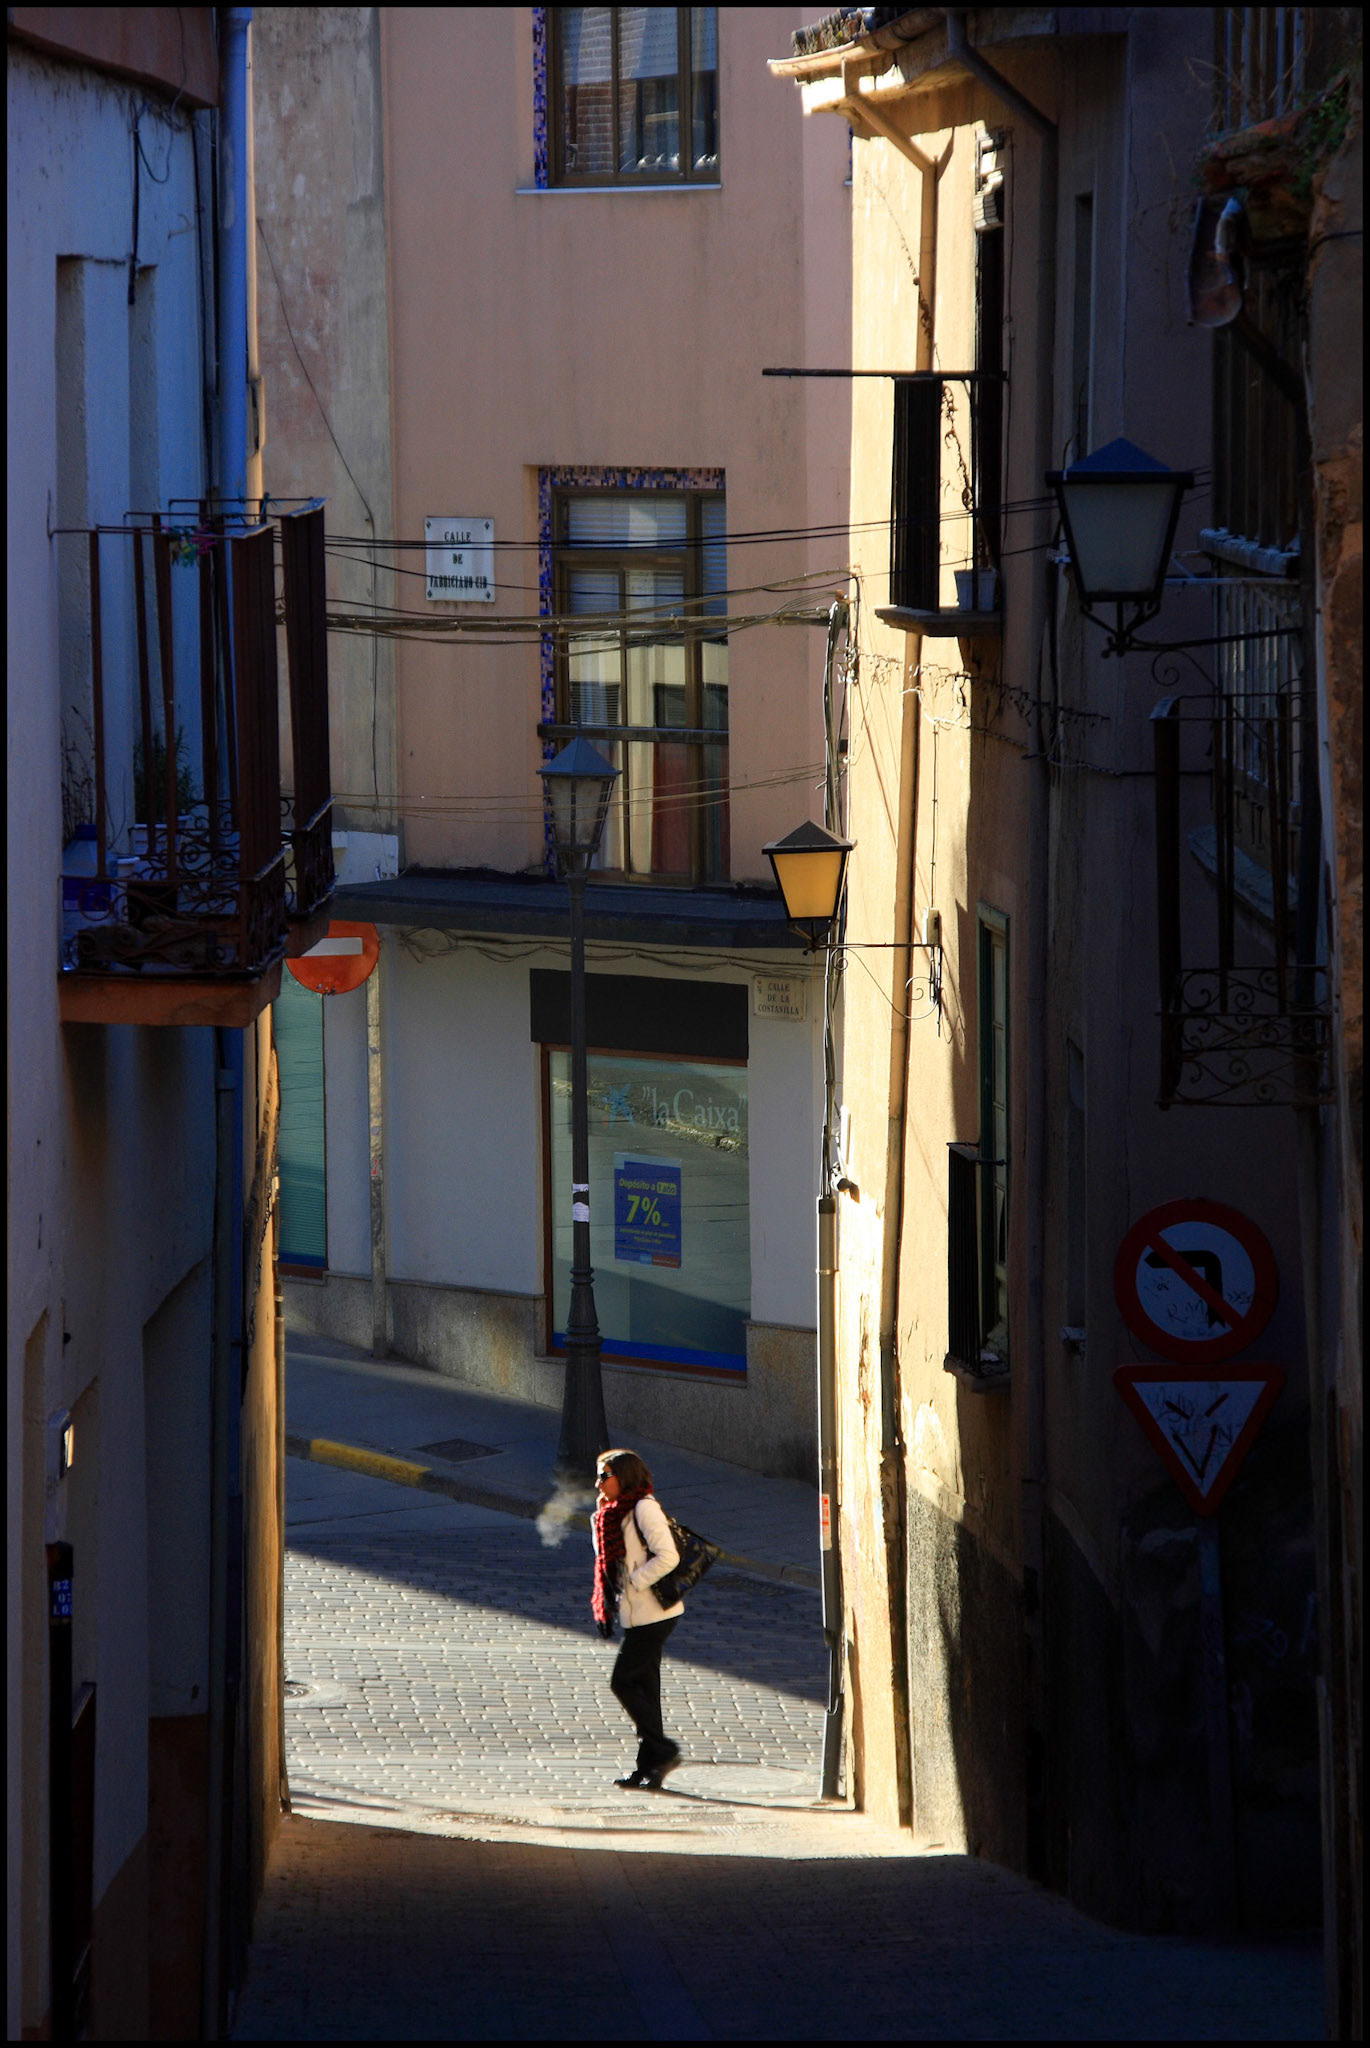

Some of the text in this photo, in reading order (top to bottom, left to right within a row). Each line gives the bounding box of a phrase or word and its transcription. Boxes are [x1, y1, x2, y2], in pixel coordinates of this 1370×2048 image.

[444, 531, 471, 543] CALLE
[452, 553, 463, 564] DE
[768, 983, 790, 991] CALLE
[767, 994, 790, 1003] DE LA
[757, 1004, 799, 1015] COSTANILLA
[626, 1194, 661, 1226] 7%
